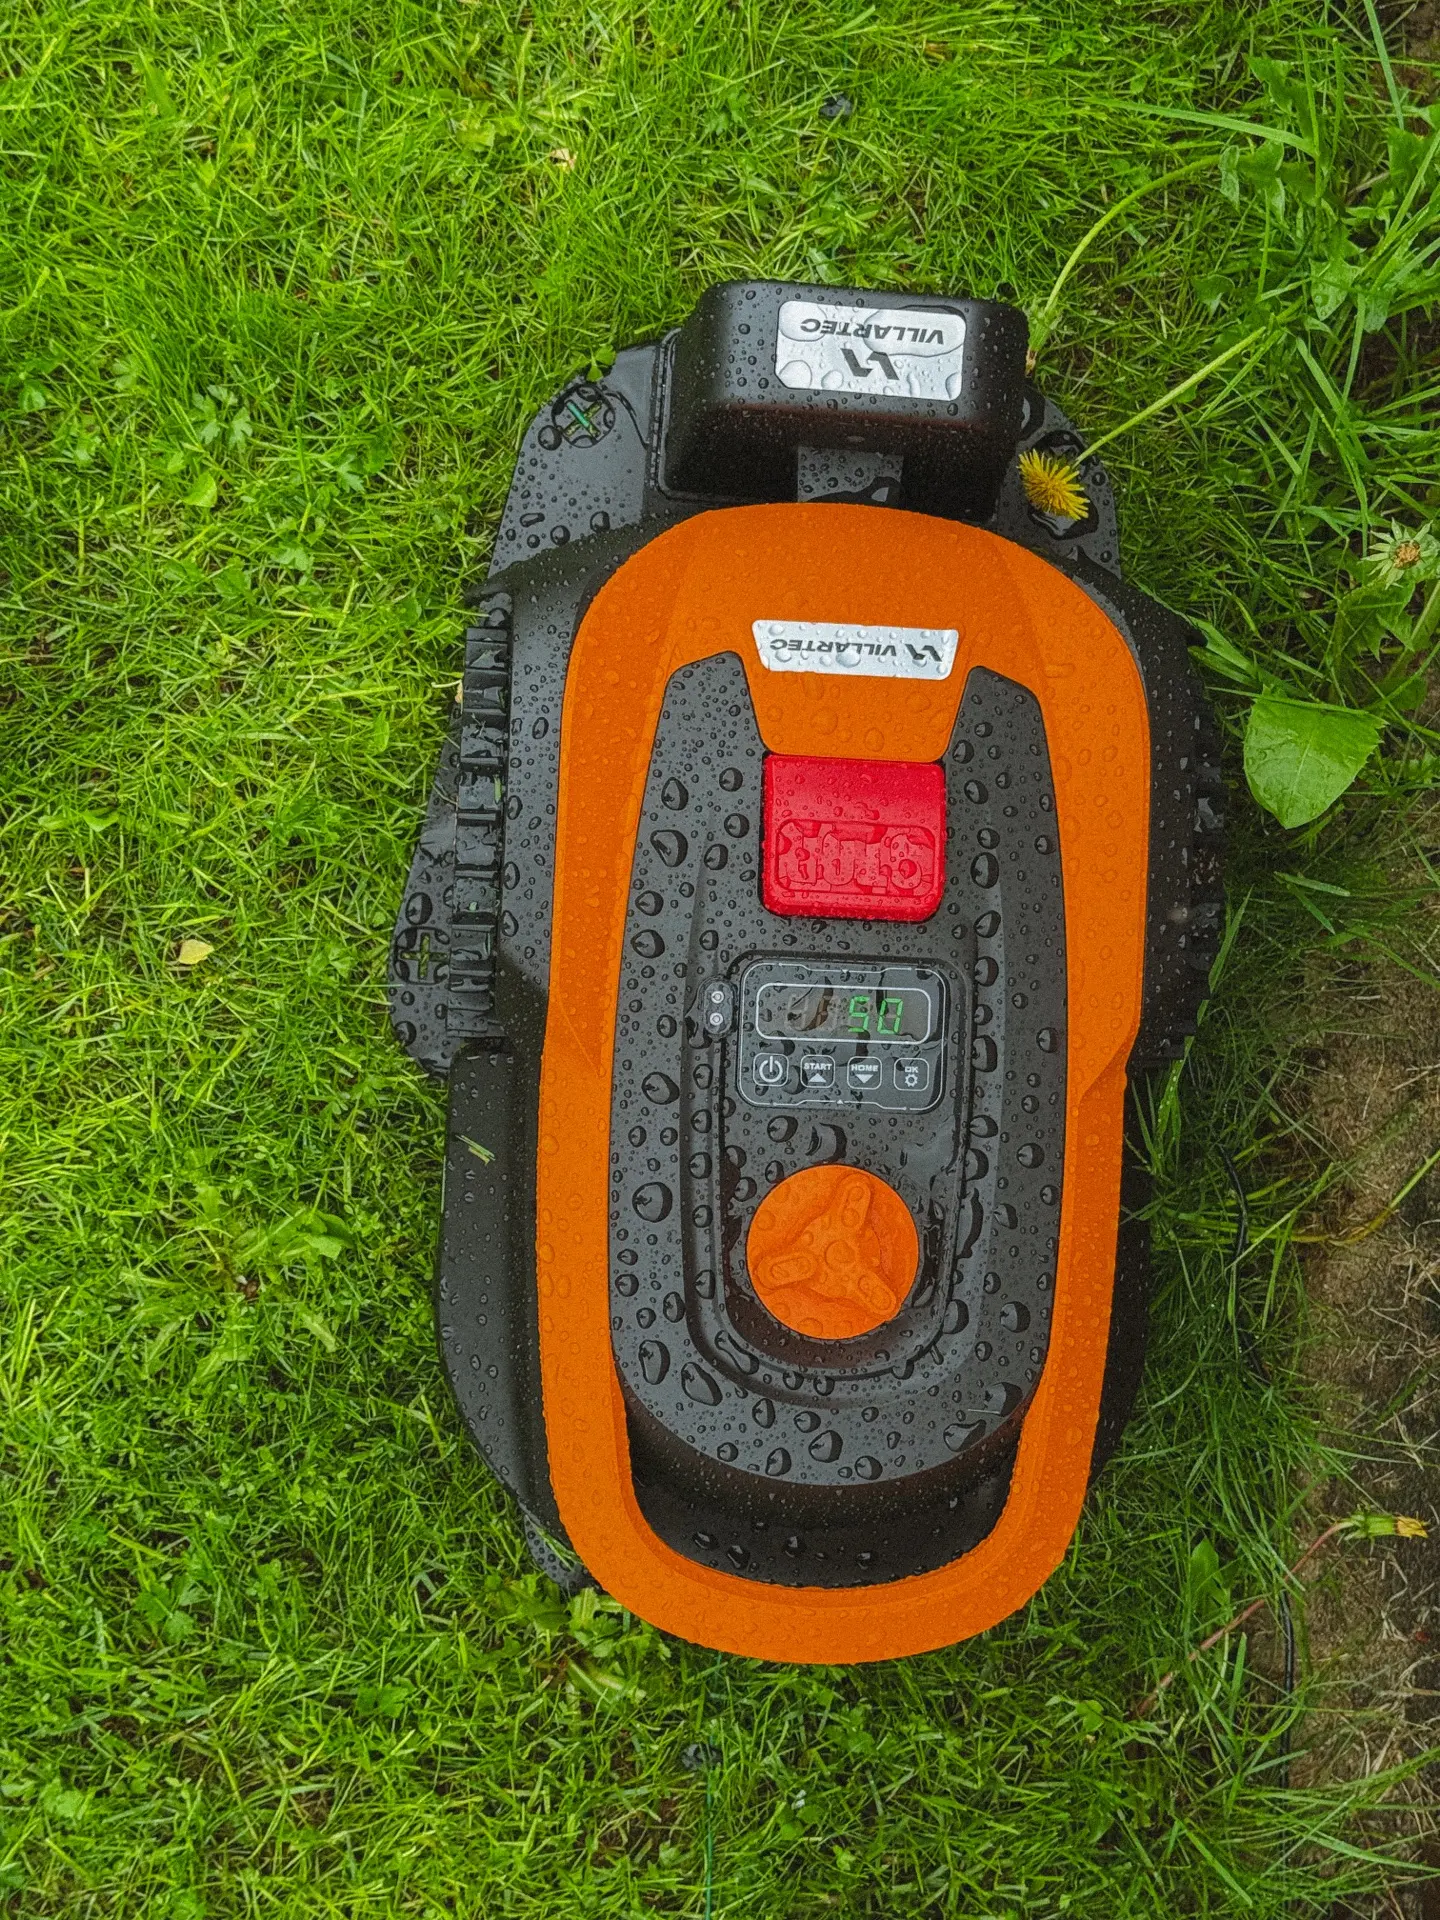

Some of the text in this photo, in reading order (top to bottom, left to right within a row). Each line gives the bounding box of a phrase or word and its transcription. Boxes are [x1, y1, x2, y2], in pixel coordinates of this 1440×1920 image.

[800, 318, 944, 345] VILLARTEC
[770, 638, 897, 657] VILLARTEC
[848, 996, 903, 1034] 50
[803, 1062, 832, 1071] START
[851, 1064, 879, 1072] HOME
